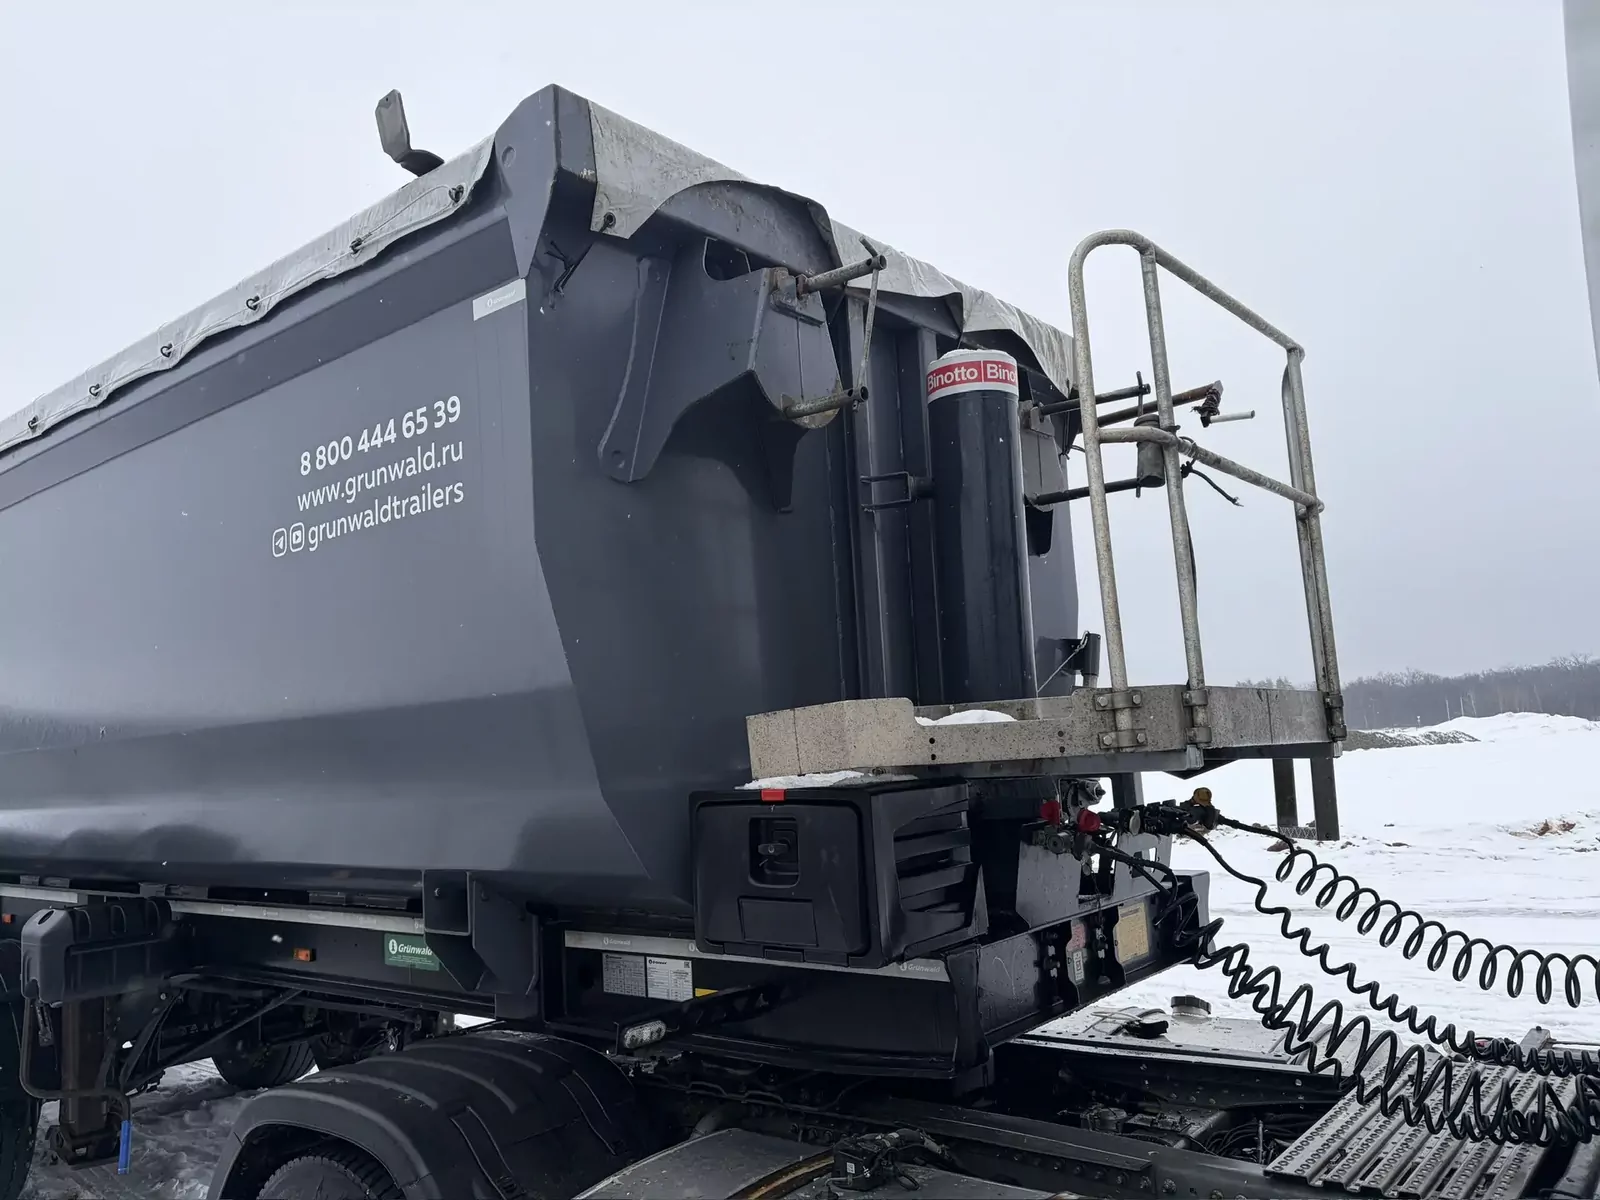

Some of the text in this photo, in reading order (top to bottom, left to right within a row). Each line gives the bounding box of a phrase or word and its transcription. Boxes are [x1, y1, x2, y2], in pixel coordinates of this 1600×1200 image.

[927, 366, 978, 391] Binotto
[300, 396, 461, 476] 8 800 444 65 39
[297, 441, 464, 511] www.grunwald.ru
[308, 482, 464, 551] grunwaldtrailers
